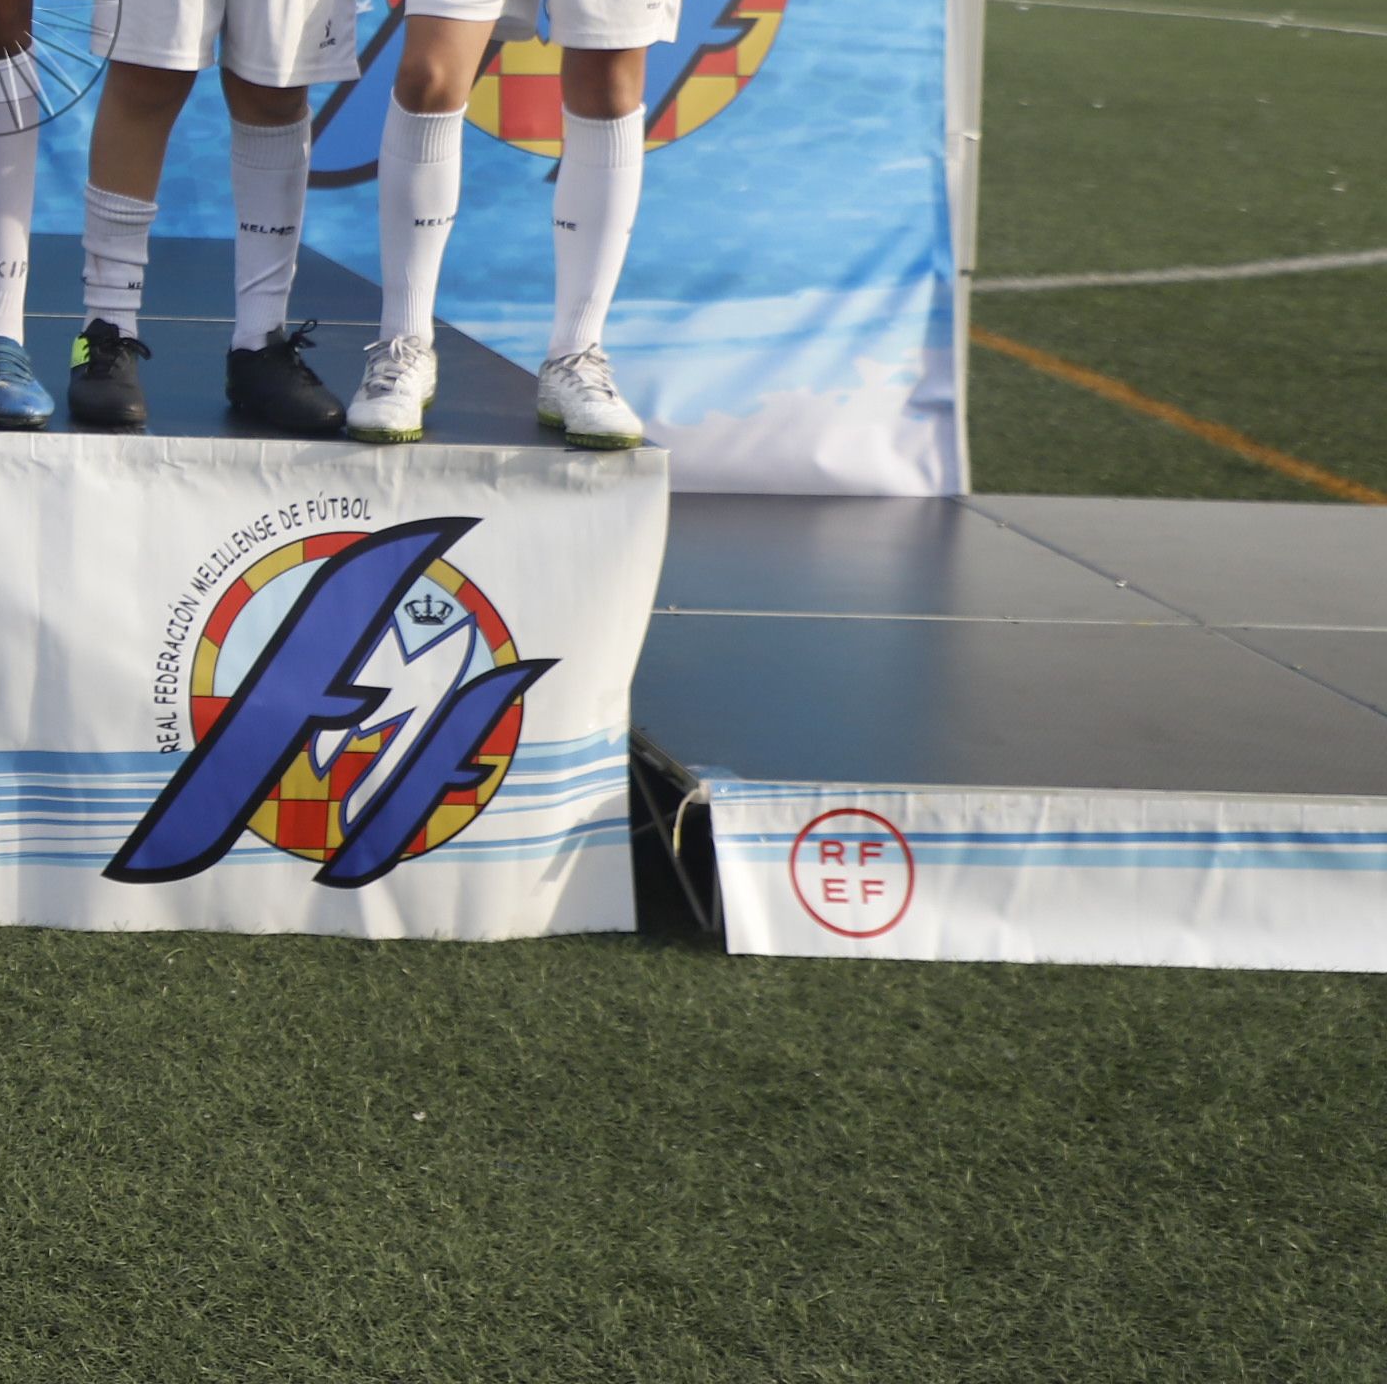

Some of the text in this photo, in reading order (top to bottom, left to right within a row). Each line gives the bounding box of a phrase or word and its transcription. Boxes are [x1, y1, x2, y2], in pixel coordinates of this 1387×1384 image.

[154, 490, 372, 755] REAL FEDERACIÓN MELILLENSE DE FÚTBOL
